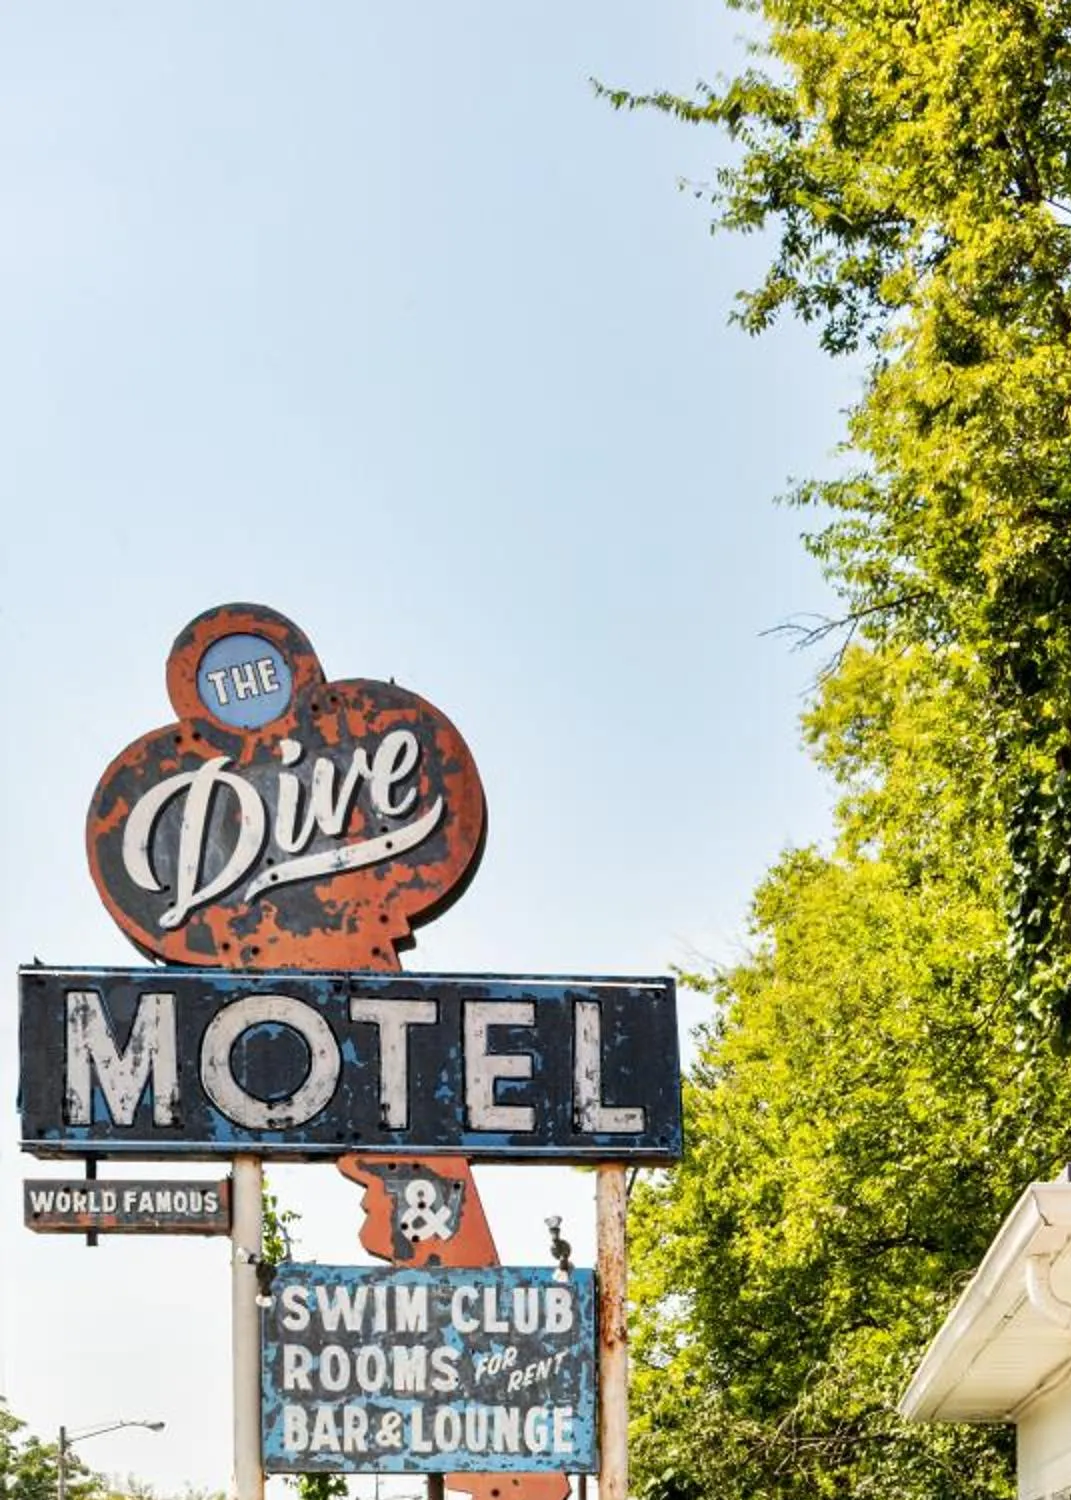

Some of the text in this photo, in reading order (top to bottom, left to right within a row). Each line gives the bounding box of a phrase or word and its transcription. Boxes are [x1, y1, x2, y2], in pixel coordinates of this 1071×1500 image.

[207, 656, 282, 705] THE
[122, 728, 422, 929] Dive
[64, 990, 647, 1133] MOTEL
[30, 1191, 219, 1213] WORLD FAMOUS
[402, 1179, 451, 1243] &
[281, 1284, 574, 1334] SWIM CLUB
[282, 1343, 460, 1392] ROOMS
[474, 1346, 518, 1384] FOR
[507, 1349, 569, 1393] RENT
[283, 1405, 369, 1453] BAR
[410, 1405, 574, 1454] LOUNGE
